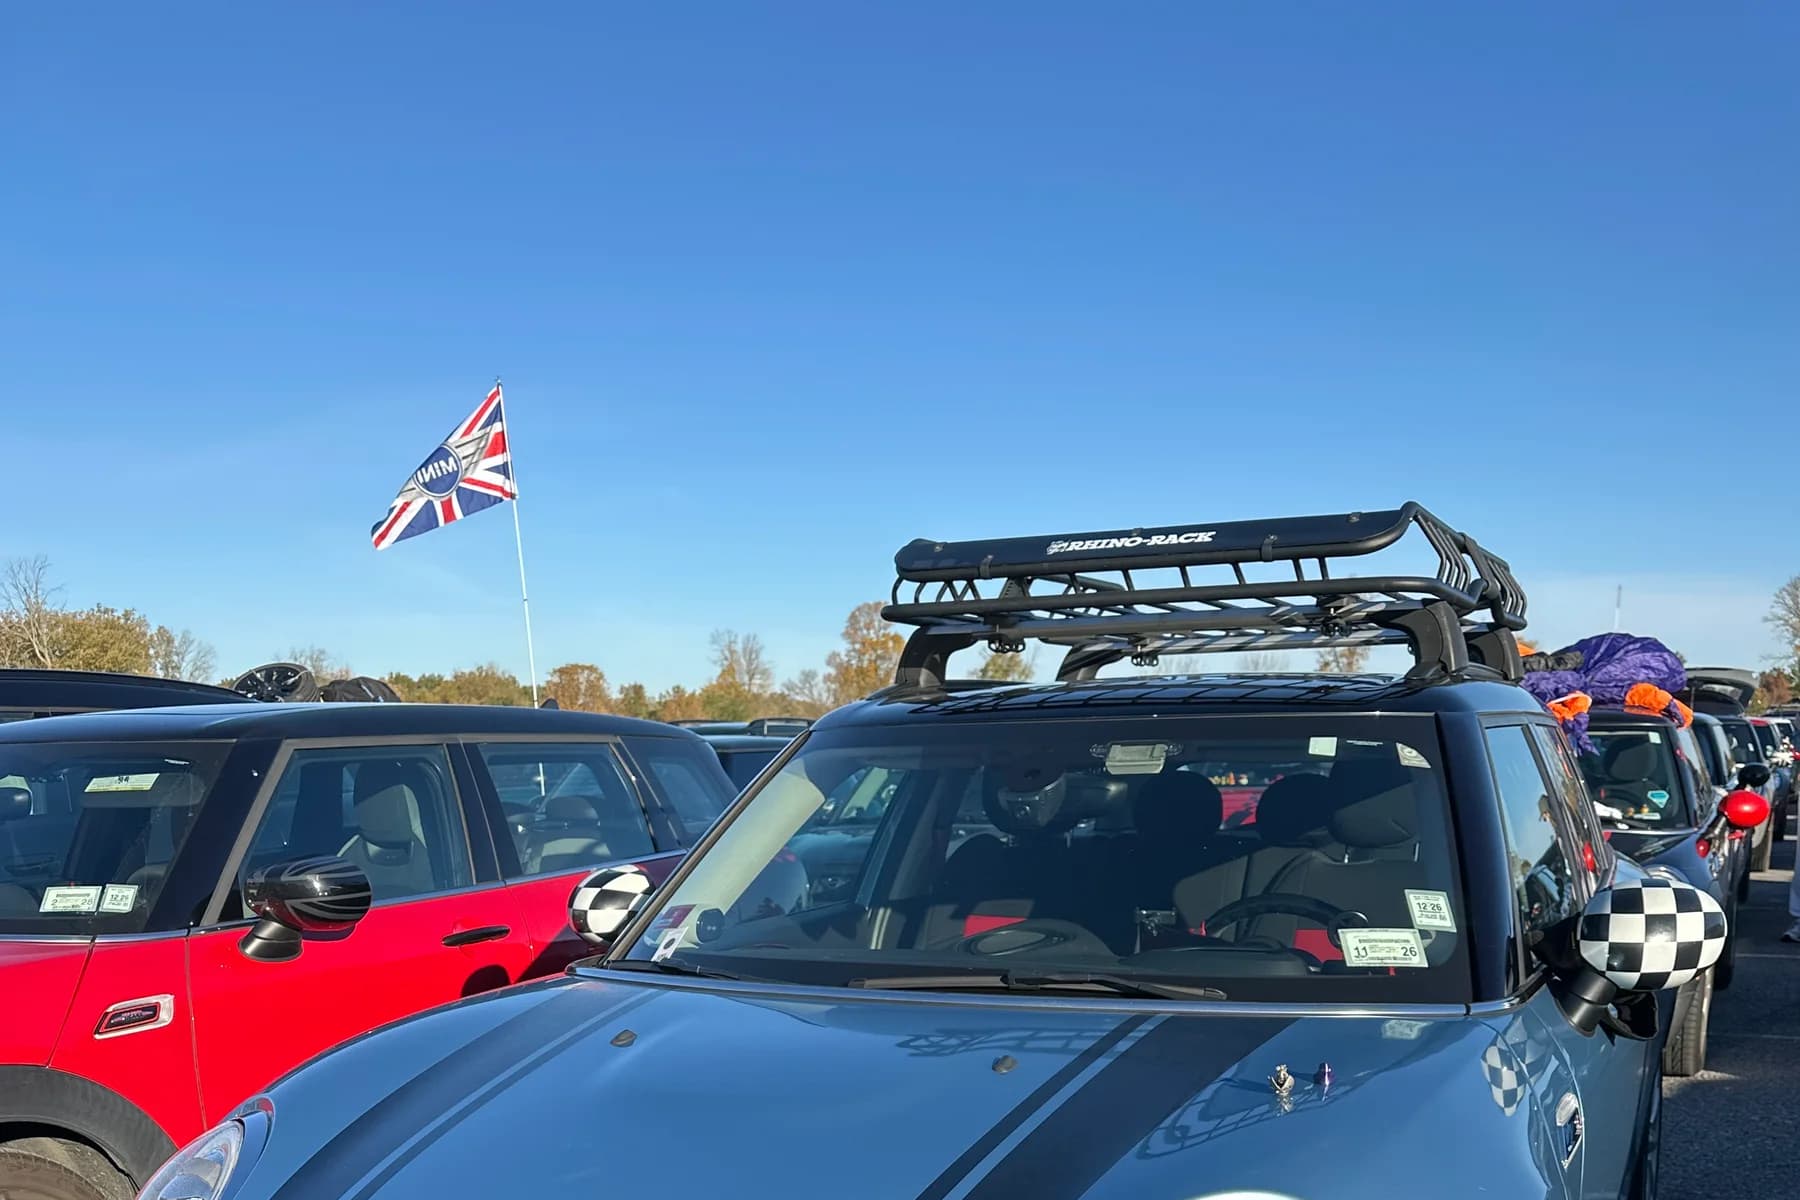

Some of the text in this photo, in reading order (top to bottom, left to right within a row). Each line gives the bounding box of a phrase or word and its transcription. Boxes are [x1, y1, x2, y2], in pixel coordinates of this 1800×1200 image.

[1063, 531, 1217, 552] RHINO-RACK
[1416, 902, 1442, 911] 12 26
[1400, 945, 1418, 957] 26
